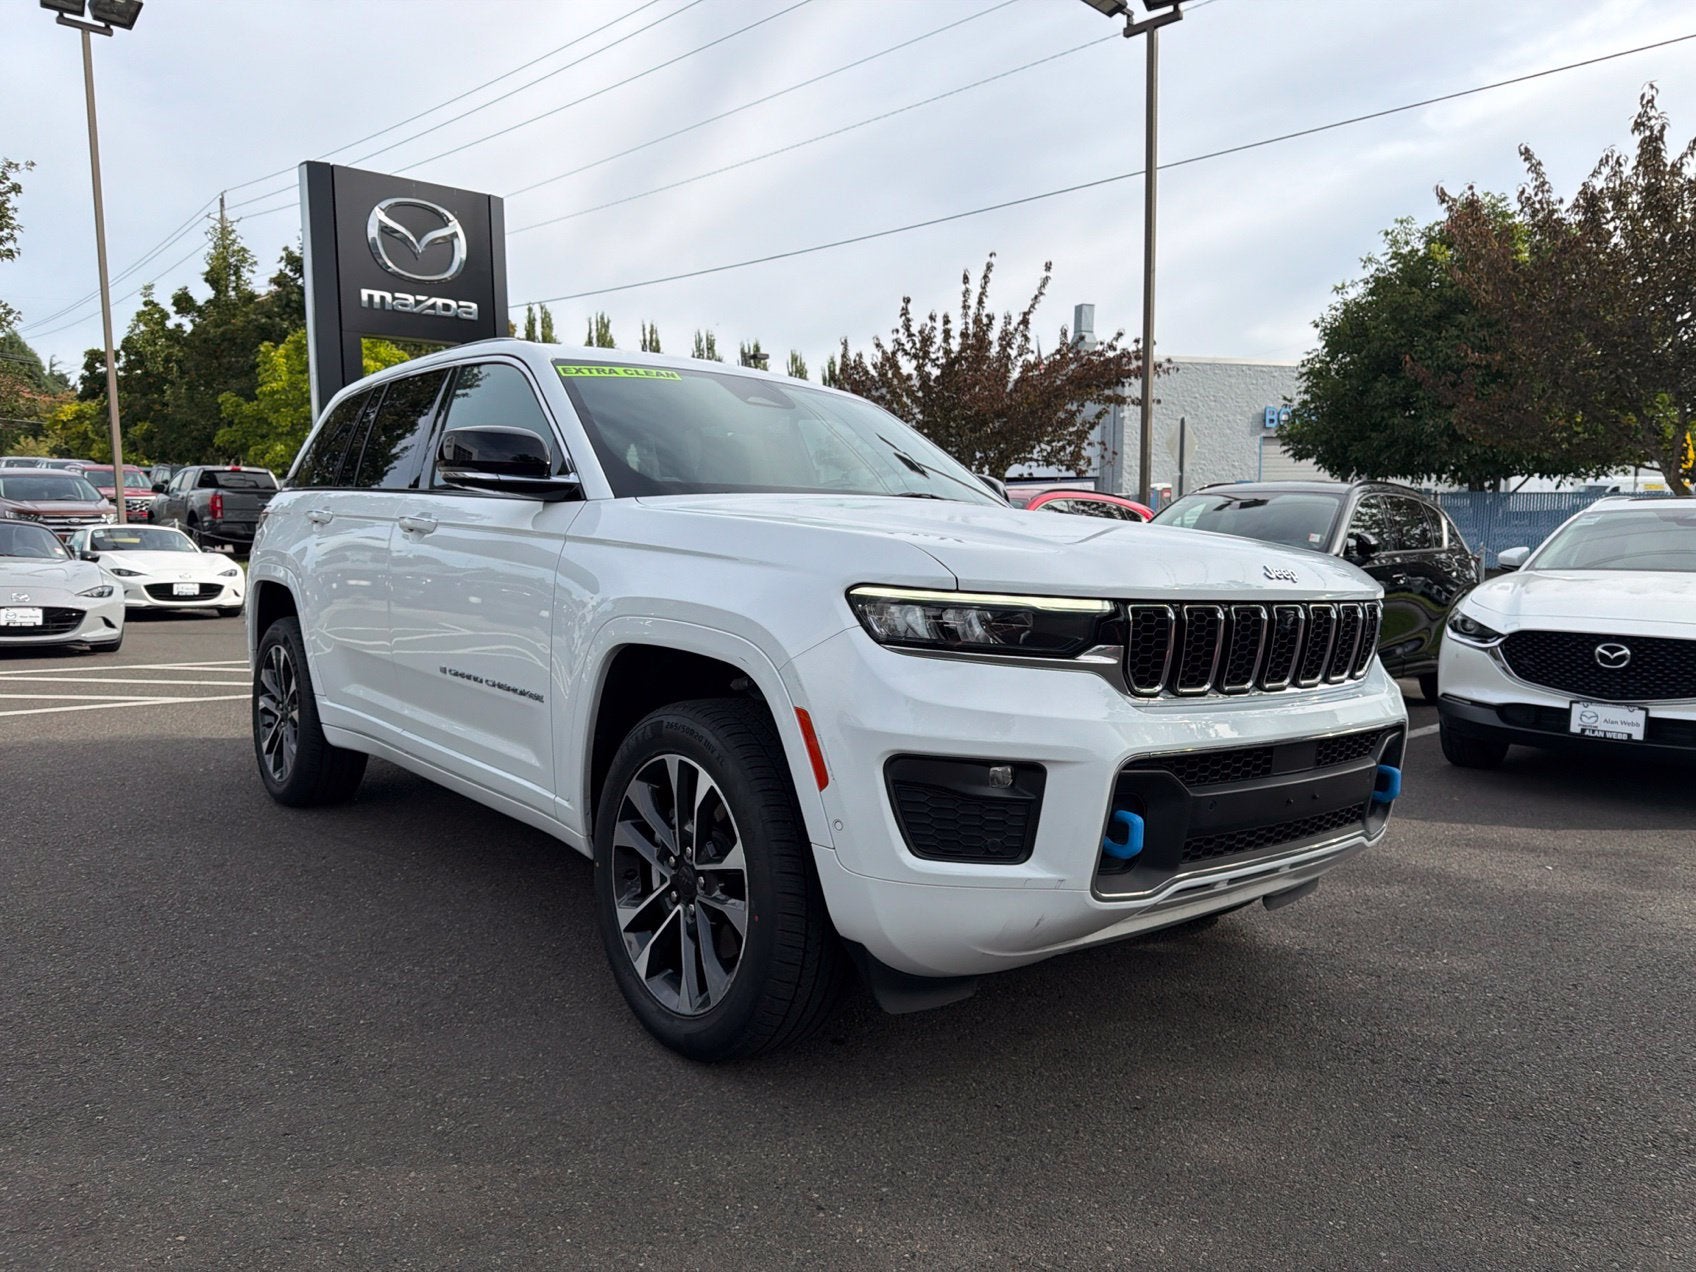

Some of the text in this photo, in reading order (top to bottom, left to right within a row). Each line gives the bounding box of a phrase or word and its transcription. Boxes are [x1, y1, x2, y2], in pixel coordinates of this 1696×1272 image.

[561, 366, 678, 379] EXTRA CLEAN
[1263, 564, 1299, 584] Jeep
[1602, 718, 1619, 726] Alan
[1620, 720, 1641, 728] Webb
[1584, 729, 1628, 740] ALAN WEBB
